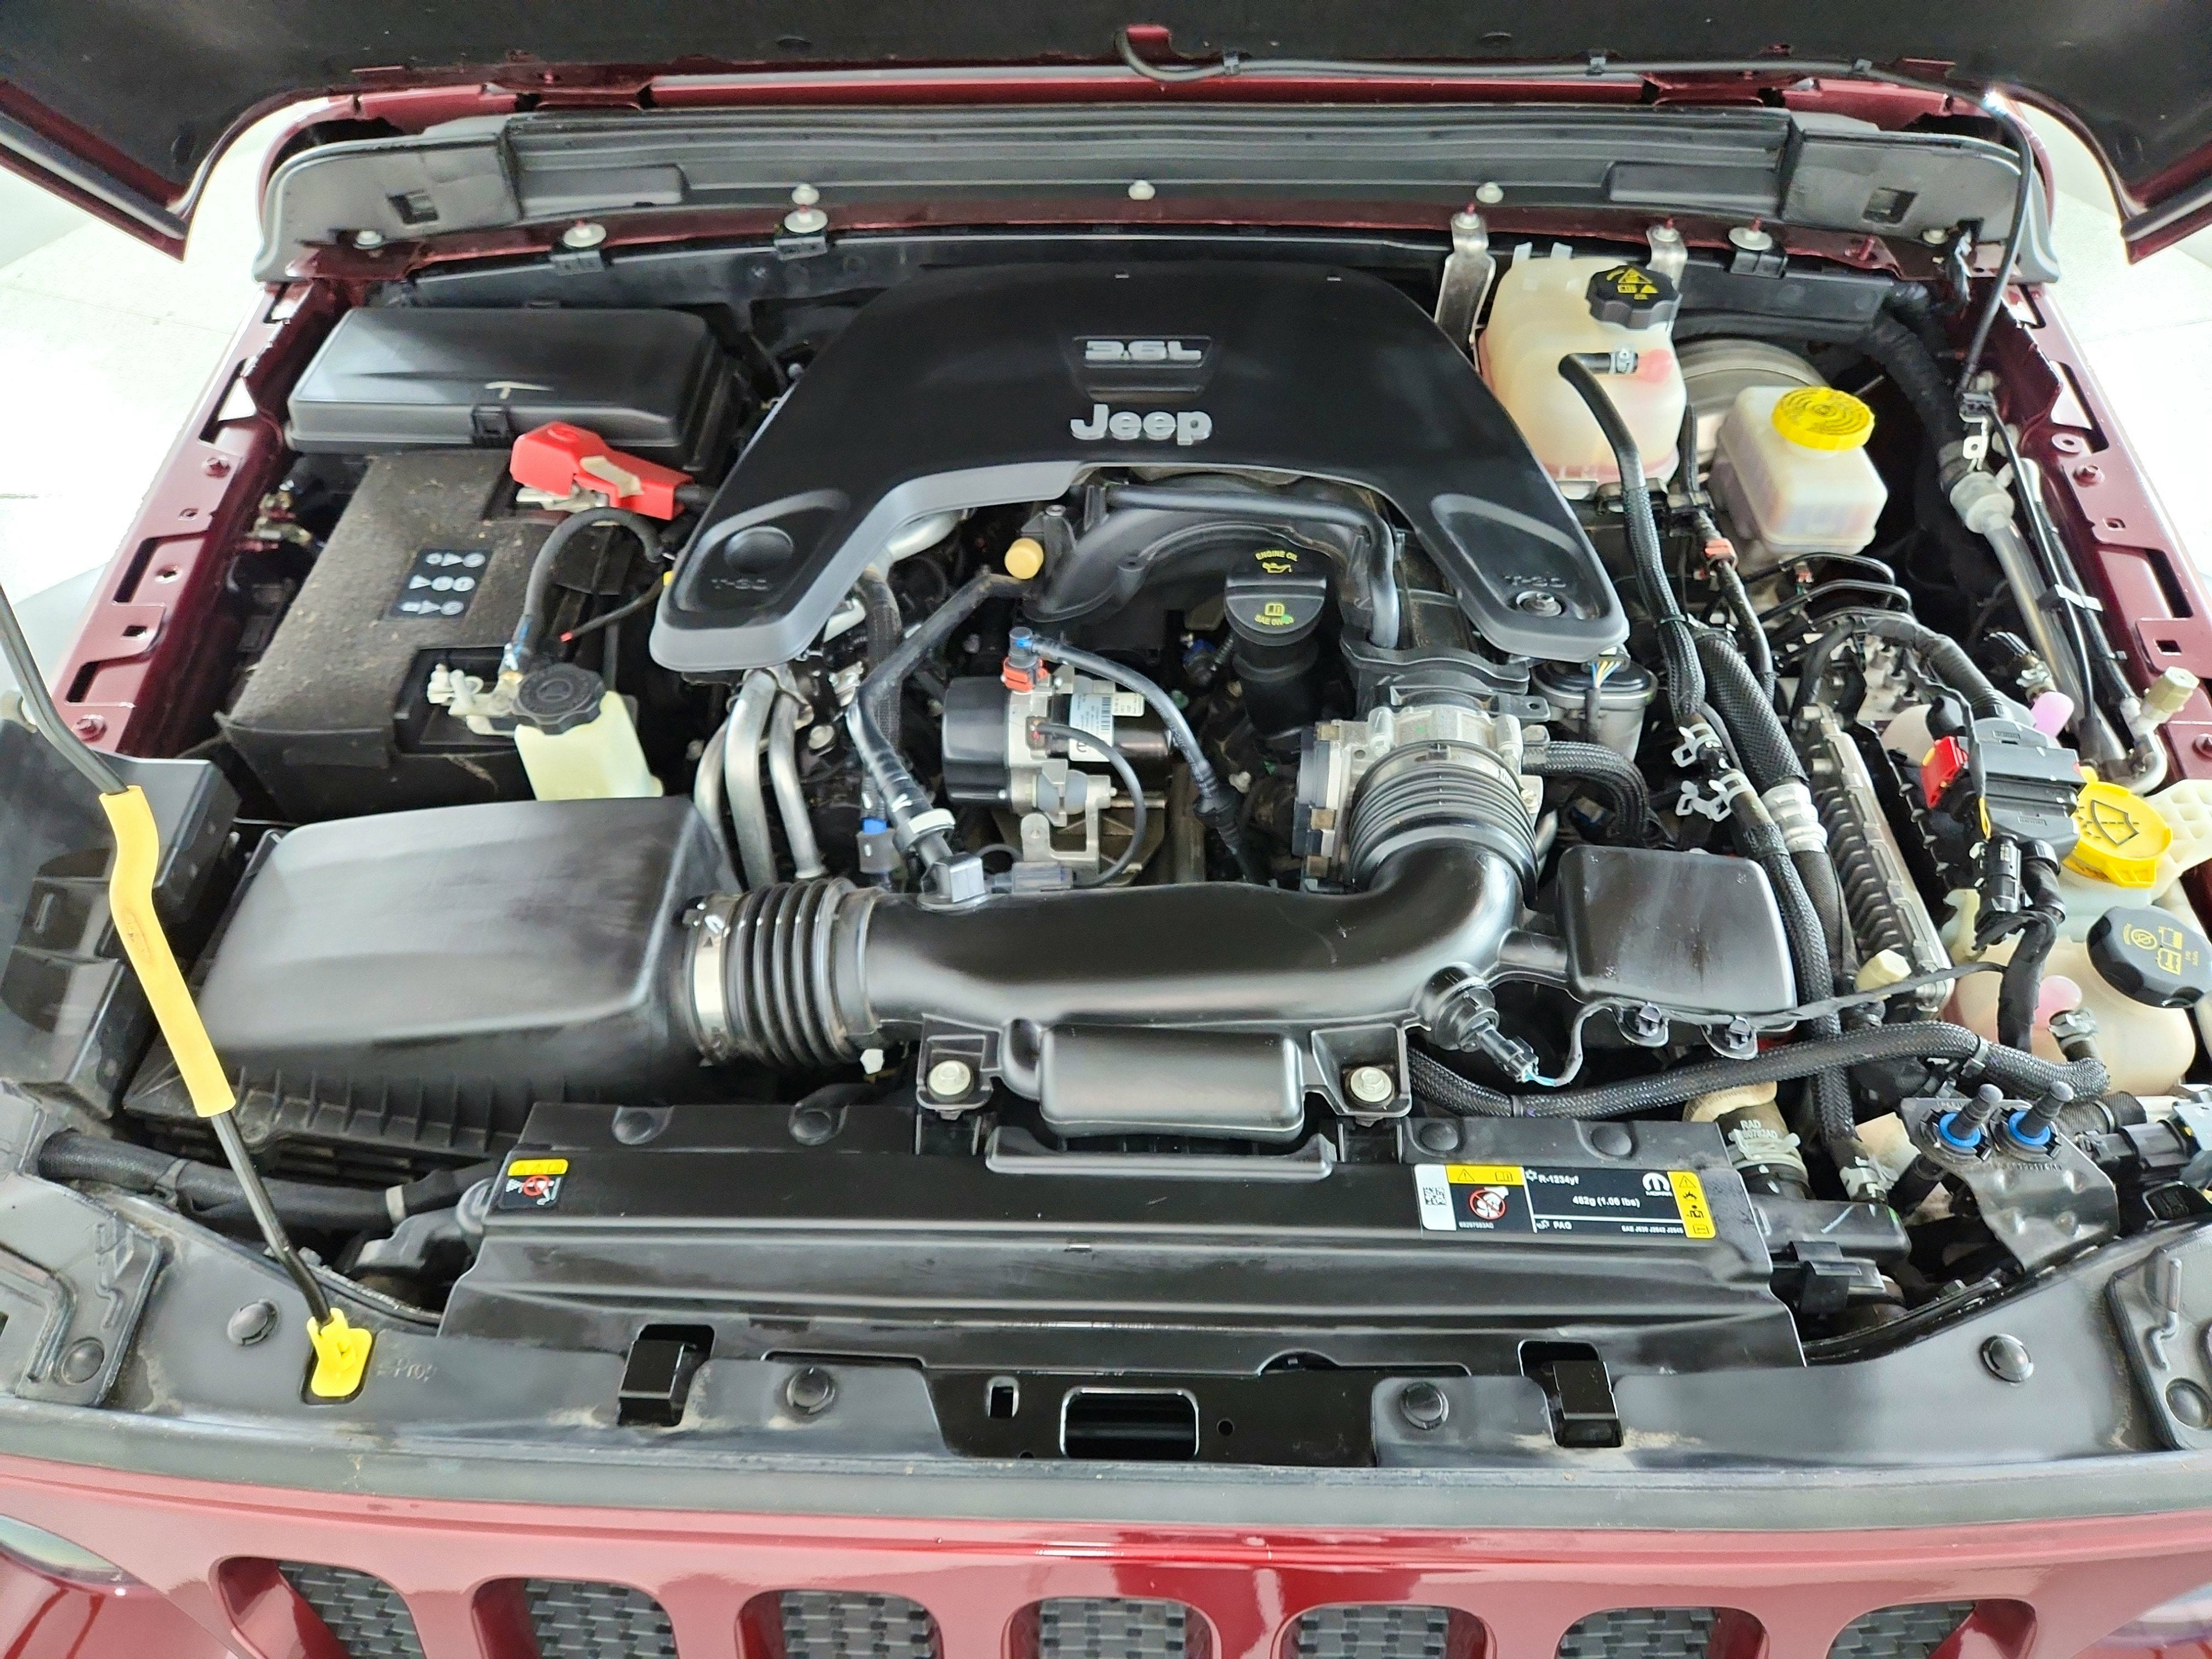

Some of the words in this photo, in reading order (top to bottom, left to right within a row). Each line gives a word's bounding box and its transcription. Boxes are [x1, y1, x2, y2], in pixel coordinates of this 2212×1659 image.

[1085, 340, 1202, 361] 3.6L
[1070, 403, 1213, 446] Jeep
[1255, 550, 1285, 560] ENGINE
[1286, 551, 1298, 562] OIL
[1254, 614, 1271, 625] SAE
[1740, 1119, 1762, 1130] RAD
[1538, 1174, 1579, 1186] R-1234yf
[1621, 1197, 1641, 1208] lbs)
[1553, 1221, 1572, 1230] PAG
